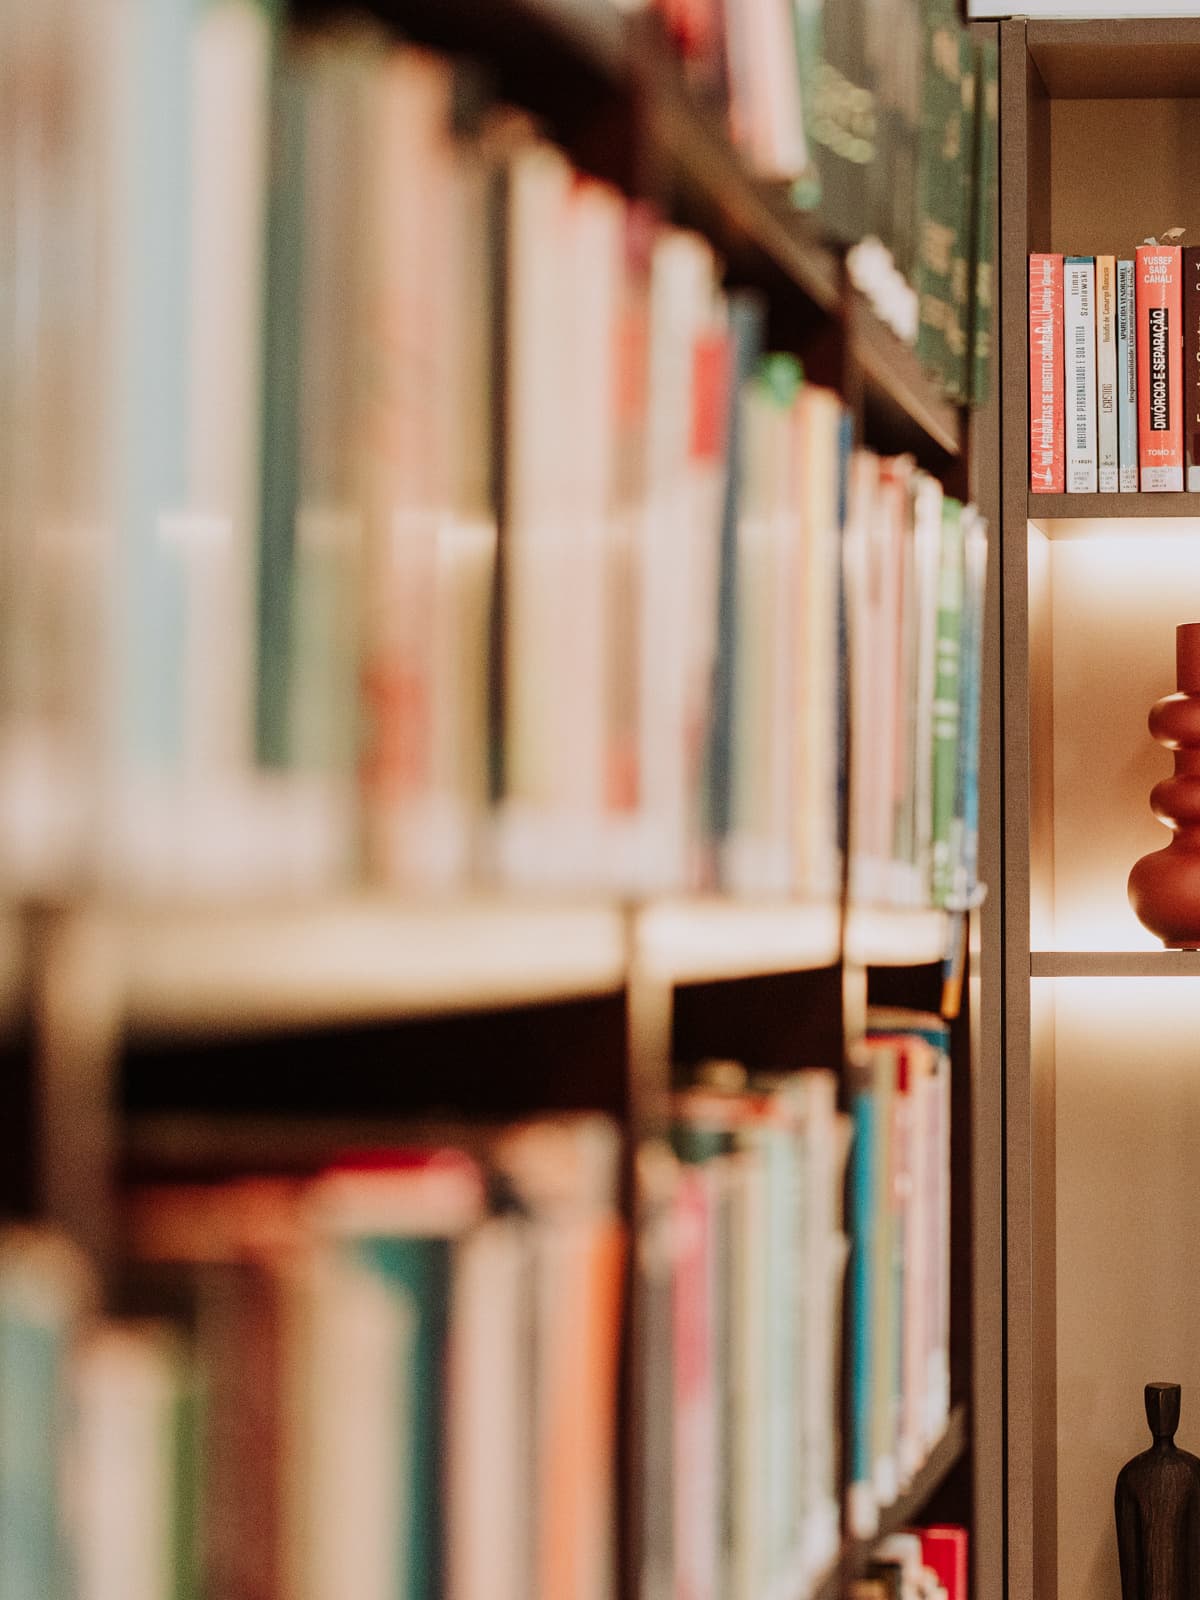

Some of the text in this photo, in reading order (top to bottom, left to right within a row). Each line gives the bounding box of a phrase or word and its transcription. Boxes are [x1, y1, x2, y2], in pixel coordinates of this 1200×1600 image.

[1144, 256, 1173, 265] YUSSEF
[1144, 274, 1172, 284] CAHALI
[1042, 363, 1053, 392] DIREITO
[1150, 310, 1168, 429] DIVÓRCIO E SEPARAÇÃO
[1042, 394, 1053, 404] DE
[1102, 383, 1112, 414] LEASING
